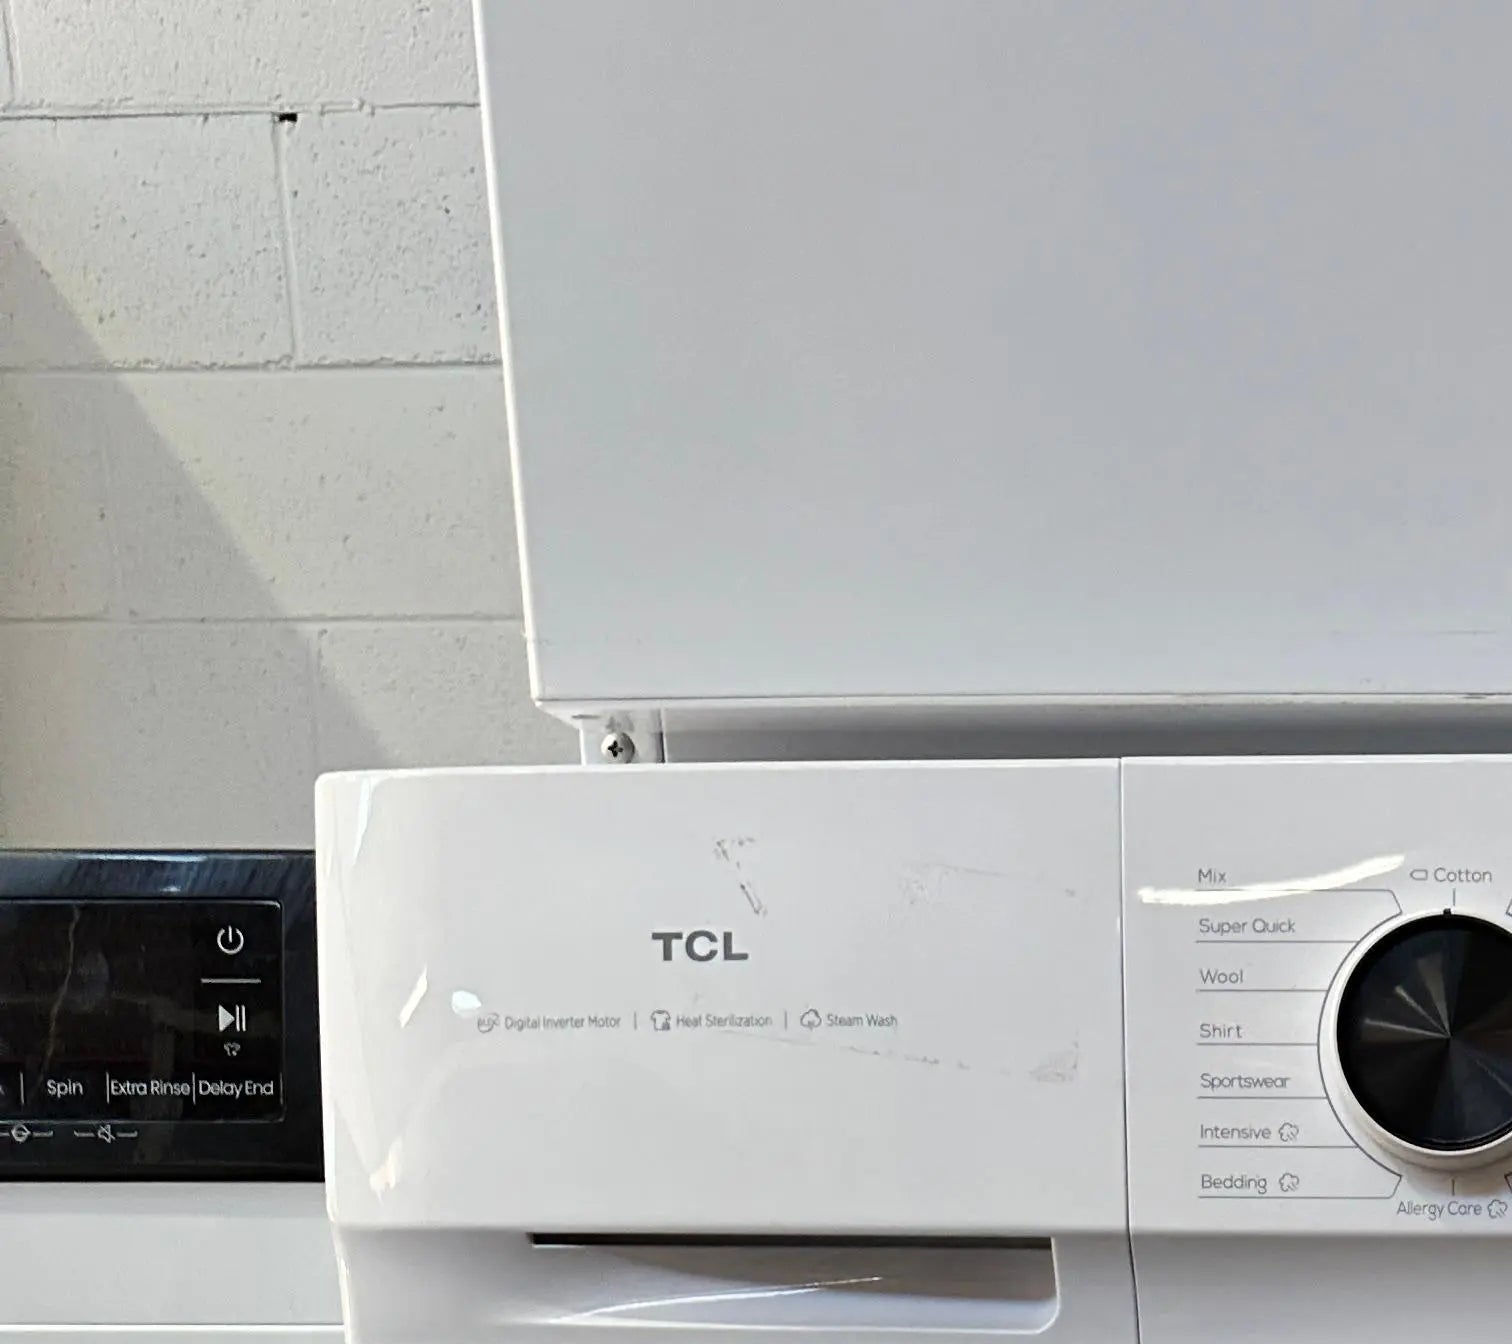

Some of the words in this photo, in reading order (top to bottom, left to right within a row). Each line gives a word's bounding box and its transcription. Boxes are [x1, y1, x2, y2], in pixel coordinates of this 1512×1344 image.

[1197, 868, 1227, 884] Mix
[1433, 867, 1493, 883] Cotton
[1199, 918, 1247, 936] Super
[1252, 918, 1296, 934] Quick
[651, 929, 749, 962] TCL
[1199, 968, 1244, 984] Wool
[504, 1013, 540, 1032] Digital
[542, 1014, 584, 1029] Inverter
[588, 1013, 621, 1029] Motor
[676, 1013, 702, 1028] Heat
[704, 1013, 773, 1028] Sterilization
[826, 1013, 863, 1028] Steam
[866, 1013, 898, 1028] Wash
[1199, 1022, 1243, 1039] Shirt
[47, 1079, 84, 1098] Spin
[111, 1081, 148, 1096] Extra
[150, 1080, 191, 1096] Rinse
[199, 1080, 243, 1099] Delay
[245, 1080, 274, 1096] End
[1199, 1072, 1292, 1092] Sportswear
[1200, 1123, 1272, 1140] Intensive
[1200, 1173, 1268, 1193] Bedding
[1396, 1200, 1444, 1221] Allergy
[1447, 1201, 1483, 1216] Care
